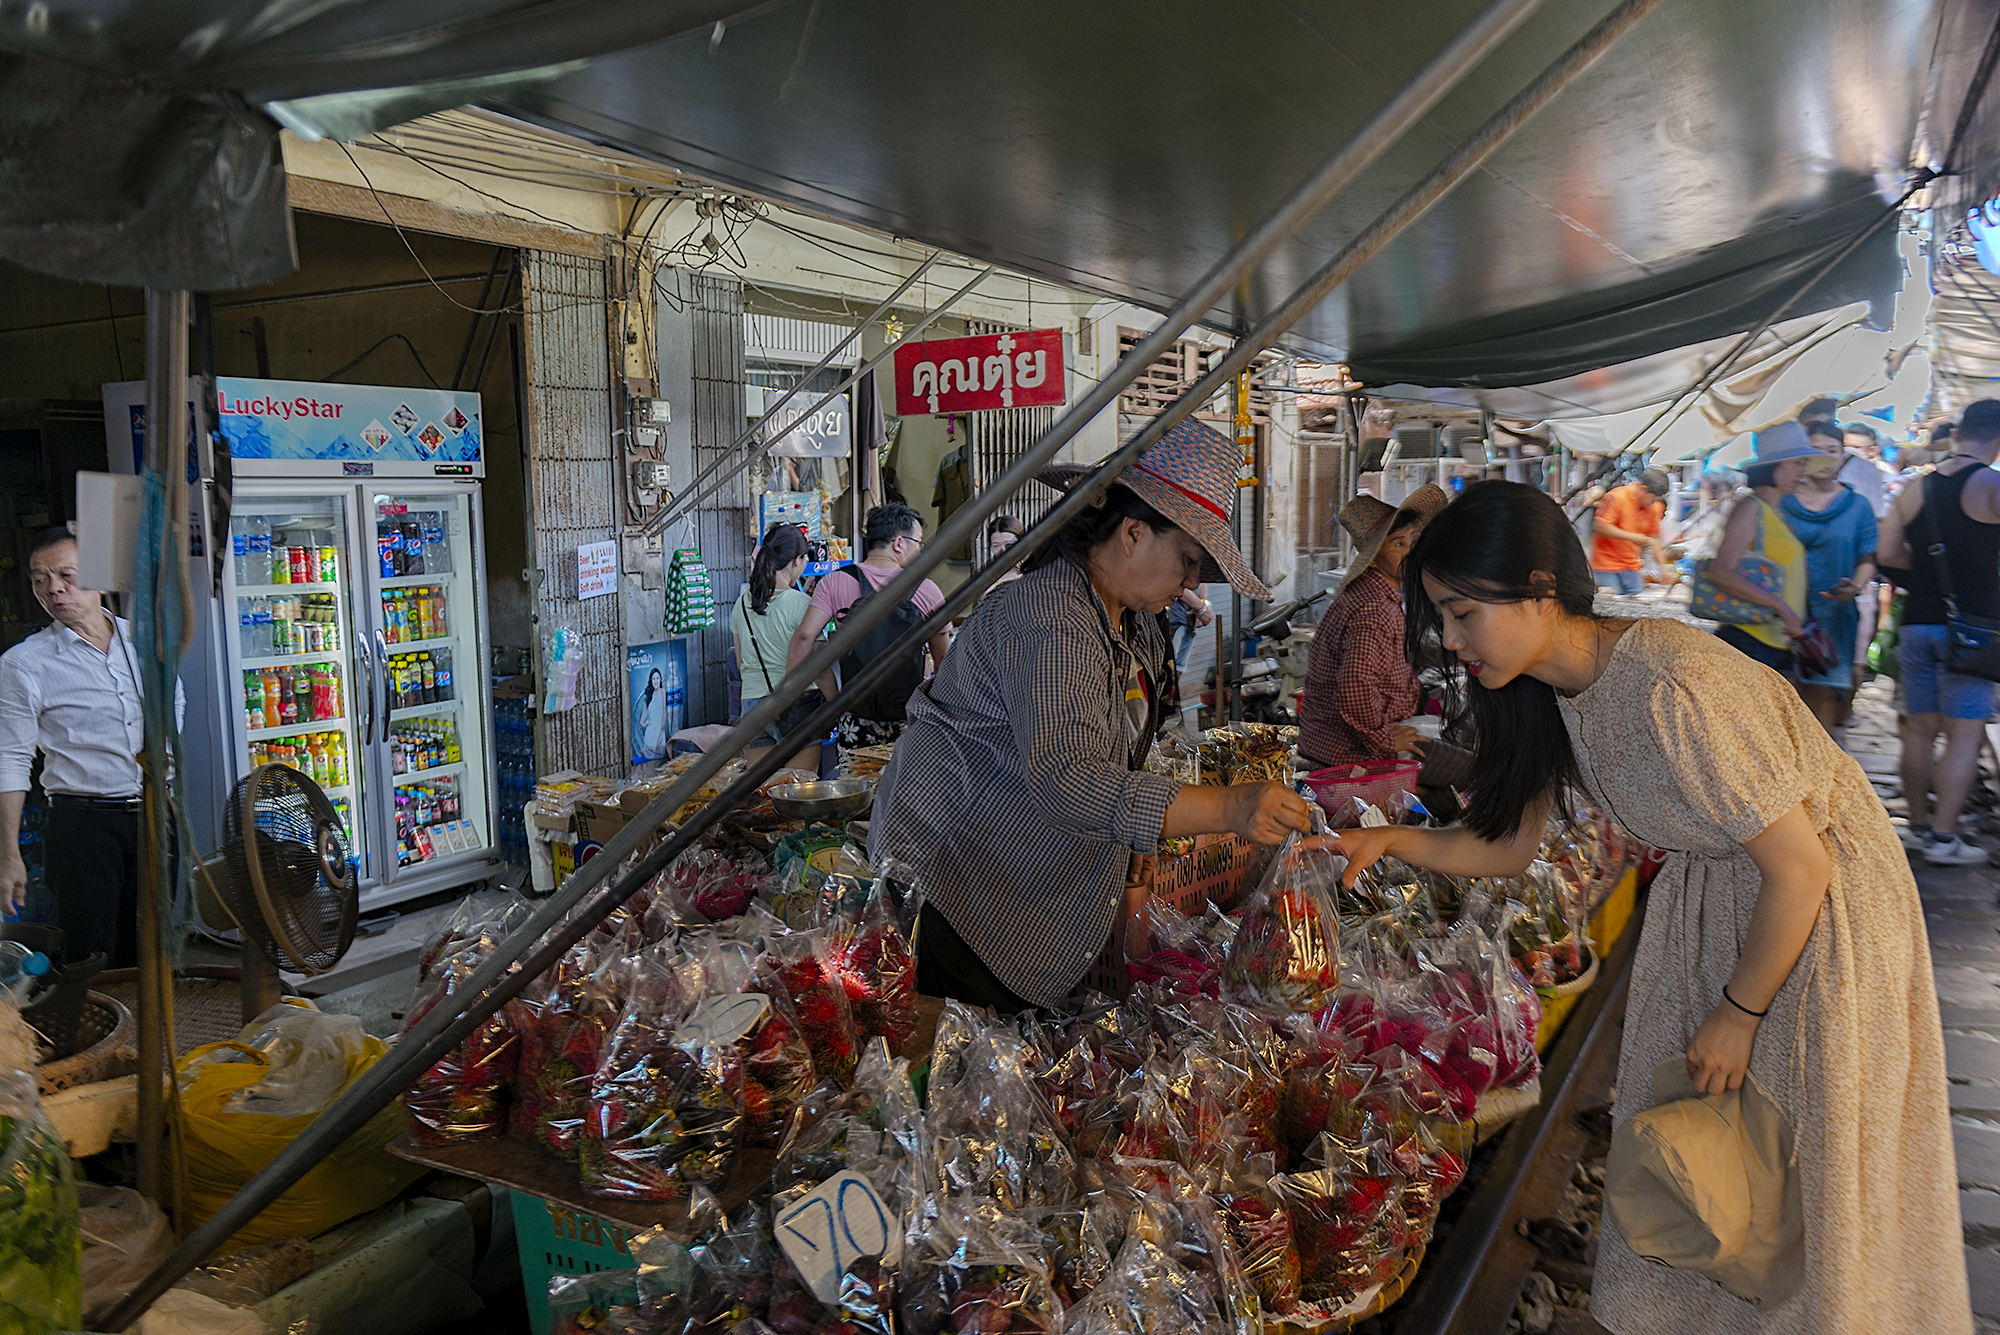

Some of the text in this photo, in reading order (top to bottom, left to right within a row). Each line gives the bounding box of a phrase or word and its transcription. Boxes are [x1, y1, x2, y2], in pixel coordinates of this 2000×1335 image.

[912, 334, 1046, 413] คุณตุ๋ย
[217, 391, 344, 420] LuckyStar
[579, 555, 591, 565] Beer
[579, 564, 617, 579] drinking water
[580, 579, 604, 593] Soft drink
[1176, 842, 1233, 888] 080-88899
[780, 1178, 888, 1277] 70
